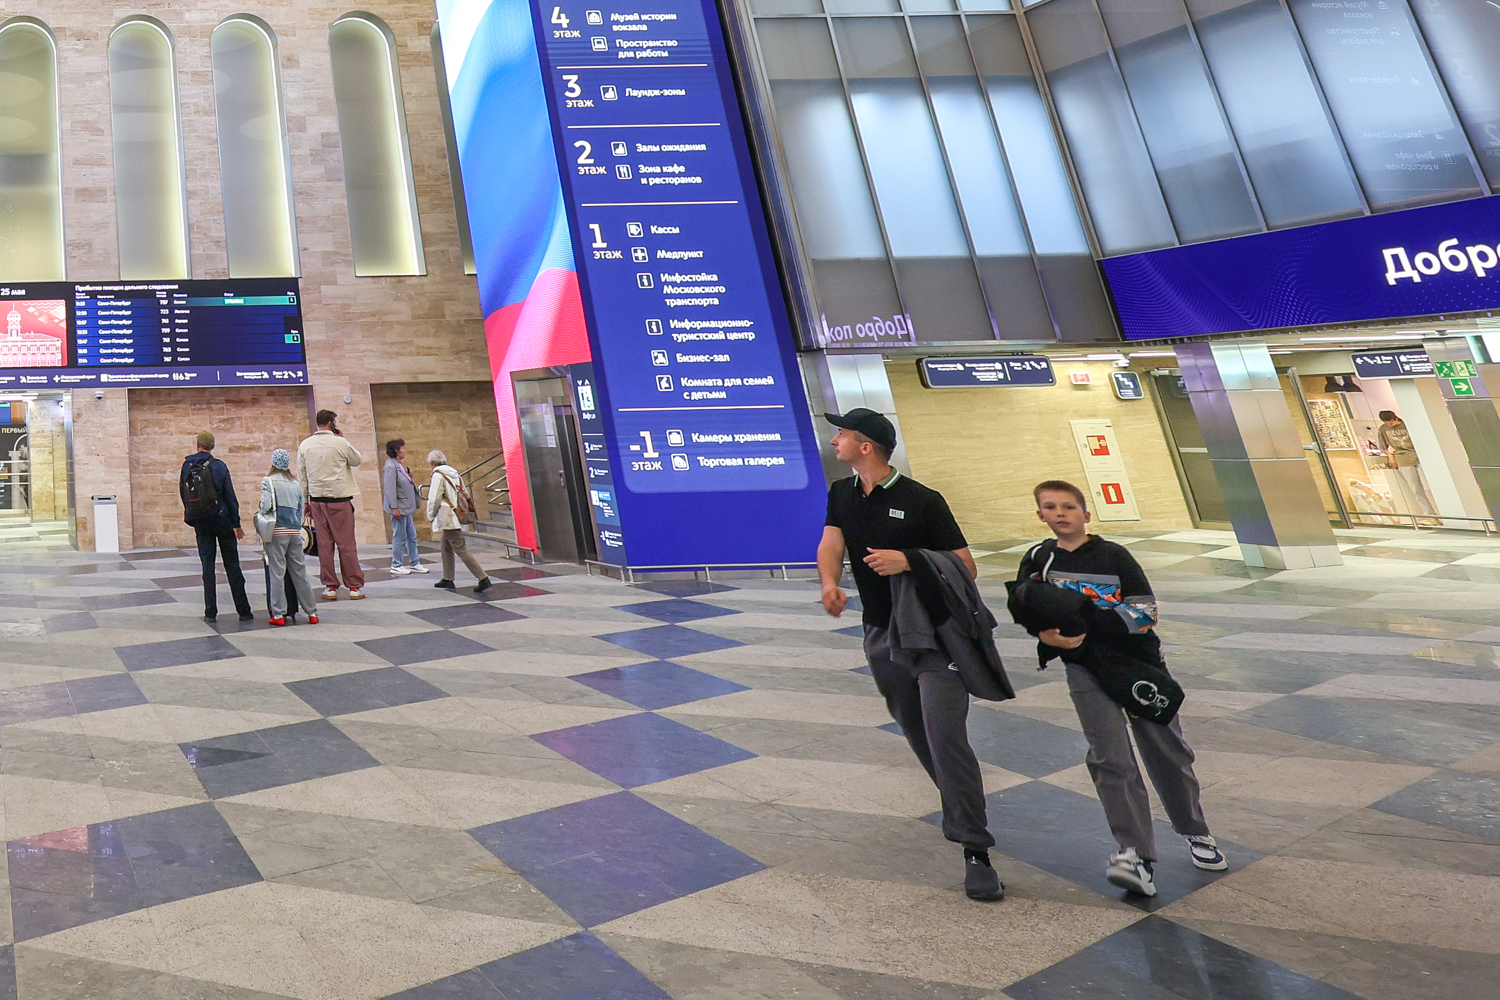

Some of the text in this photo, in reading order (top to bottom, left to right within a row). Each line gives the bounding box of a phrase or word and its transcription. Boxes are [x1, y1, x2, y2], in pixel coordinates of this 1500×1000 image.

[551, 7, 569, 28] 4
[611, 13, 639, 22] Музей
[612, 24, 647, 32] вокзала
[553, 30, 581, 38] этаж
[616, 39, 678, 48] Пространство
[636, 49, 668, 59] работы
[563, 75, 581, 97] 3
[626, 88, 685, 98] Лаундж-зоны
[574, 140, 594, 164] 2
[636, 143, 706, 152] Залы ожидания
[638, 164, 685, 174] Зона кафе
[641, 177, 702, 185] и ресторанов
[651, 225, 679, 234] Кассы
[589, 224, 607, 248] 1
[593, 251, 623, 259] этаж
[657, 250, 703, 260] Медпункт
[660, 273, 718, 283] Инфостойка
[663, 285, 725, 294] Московского
[665, 298, 719, 307] транспорта
[670, 319, 753, 330] Информационно-
[672, 331, 755, 342] туристский центр
[676, 353, 730, 362] Бизнес-зал
[681, 376, 774, 387] Комната для семей
[691, 391, 726, 400] детьми
[692, 433, 781, 444] Камеры хранения
[630, 431, 659, 458] -1
[632, 461, 663, 470] этаж
[697, 457, 785, 468] Торговая галерея
